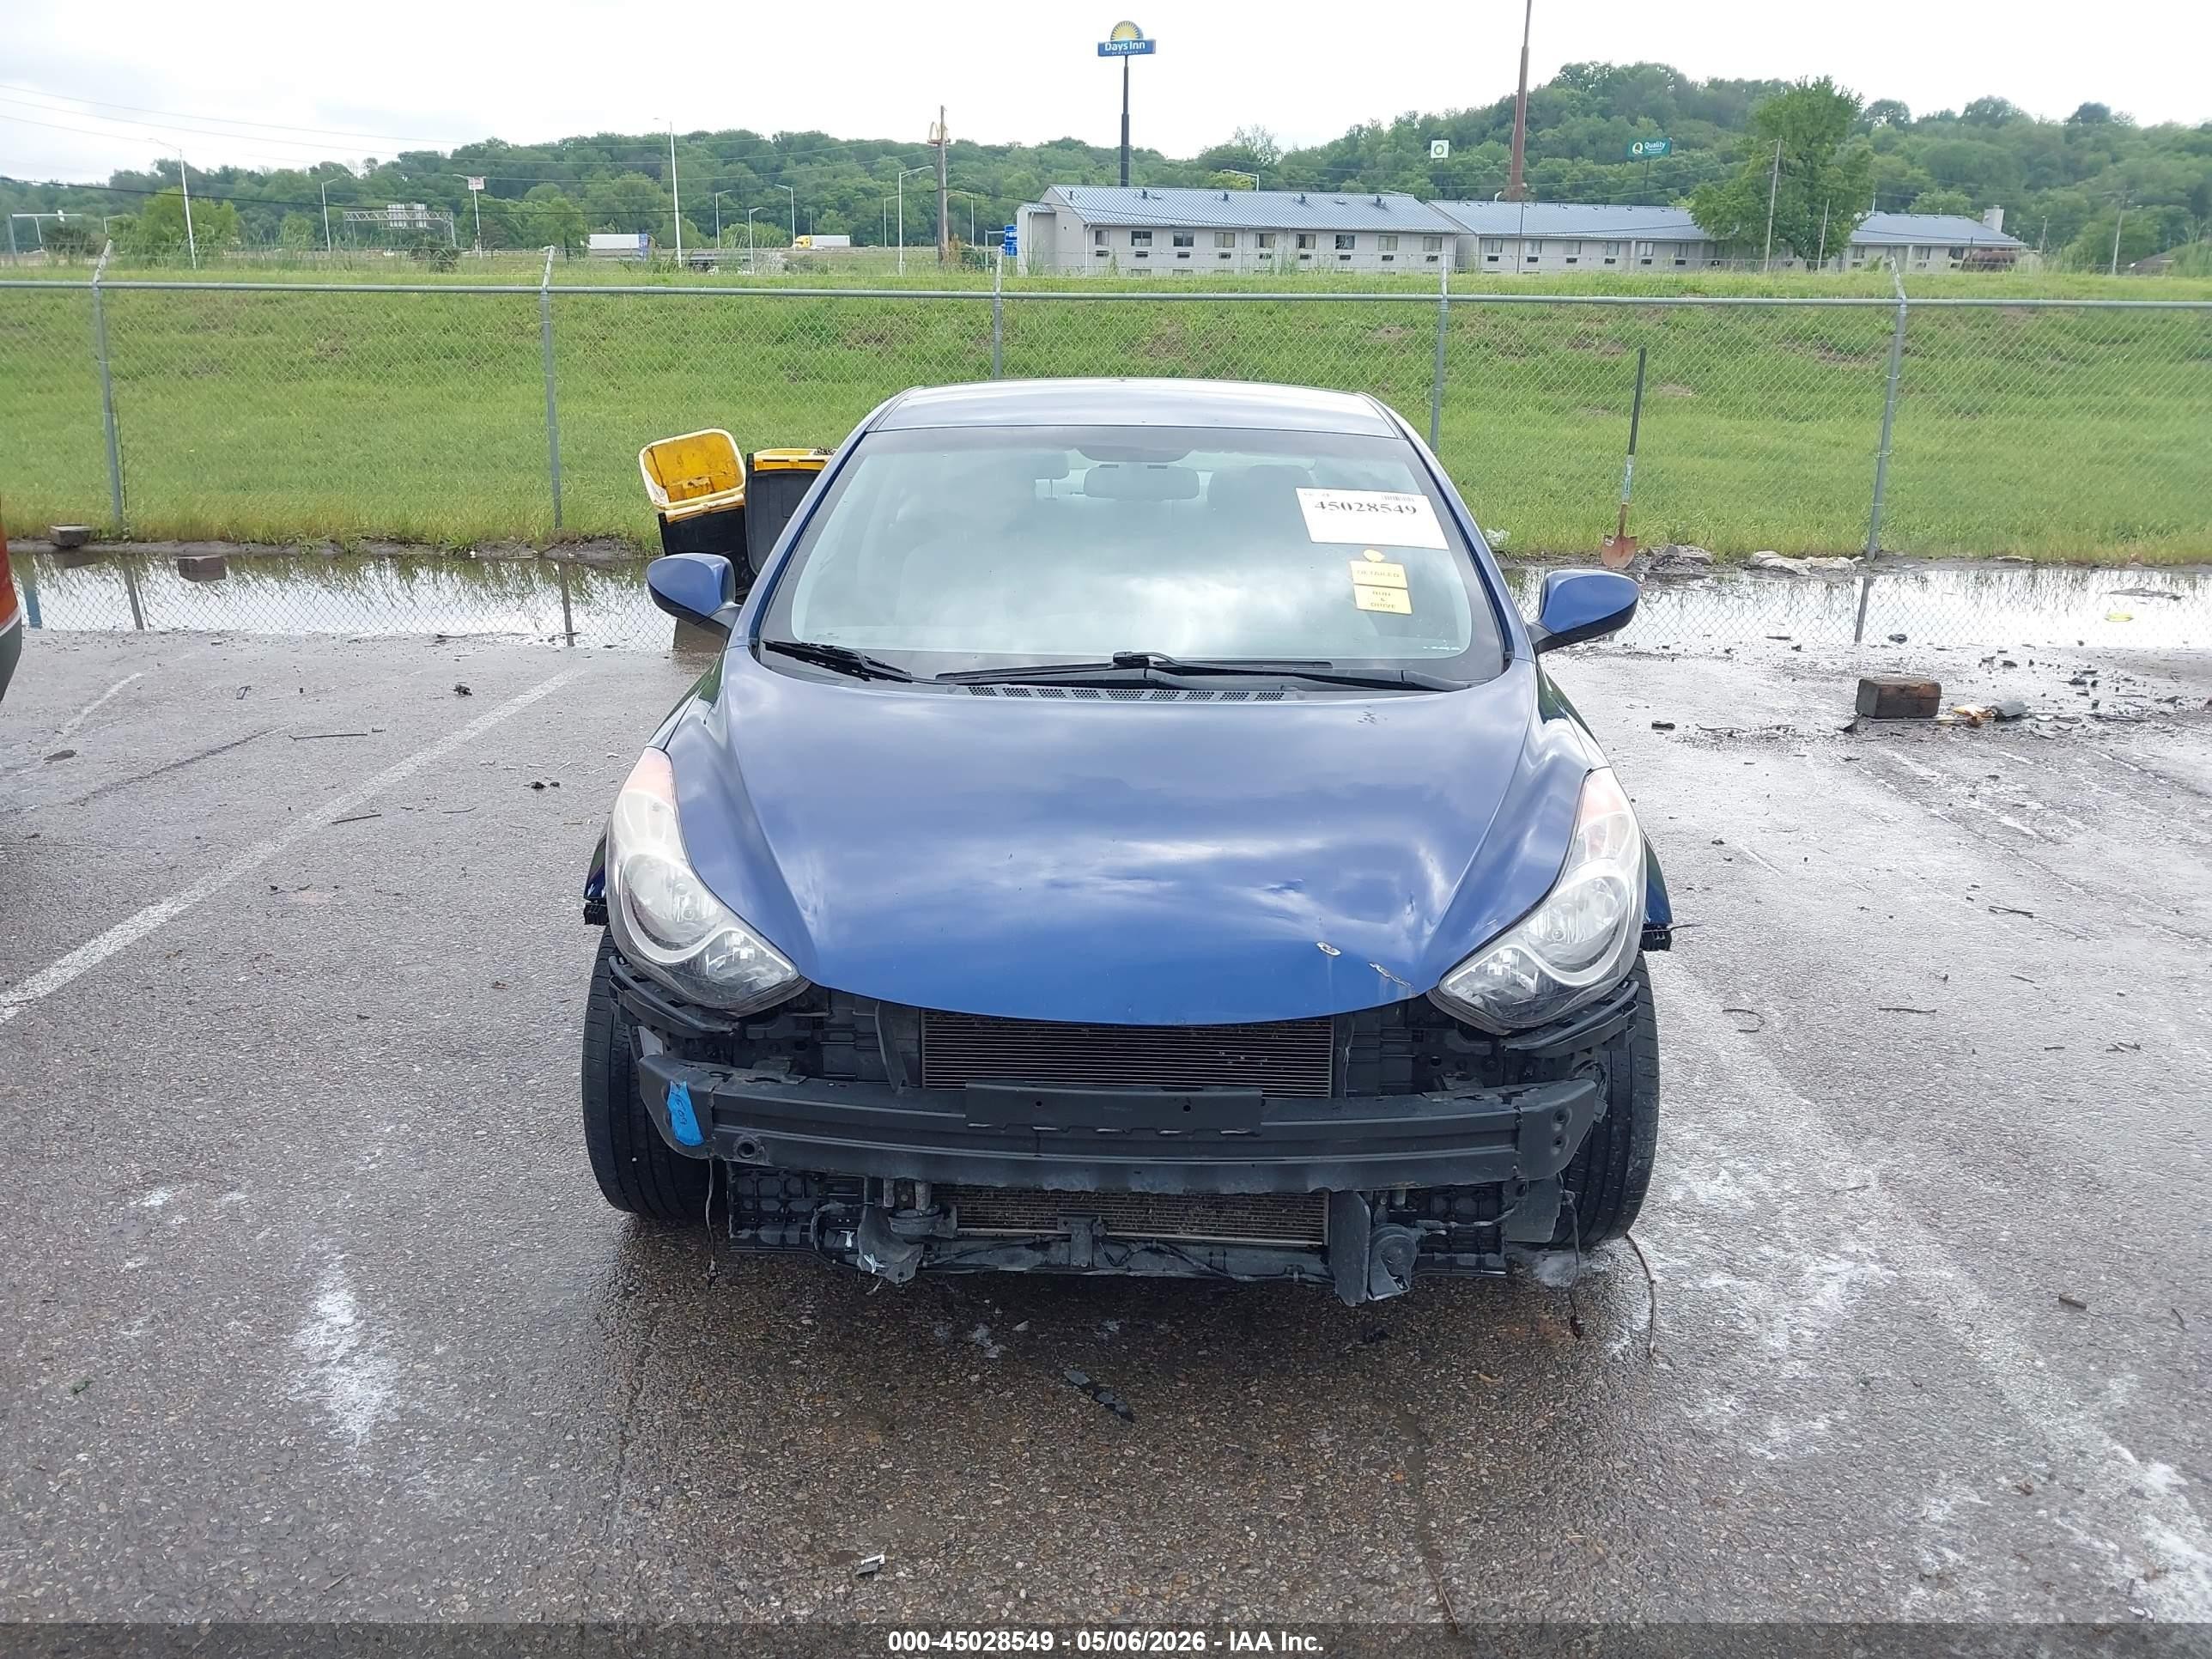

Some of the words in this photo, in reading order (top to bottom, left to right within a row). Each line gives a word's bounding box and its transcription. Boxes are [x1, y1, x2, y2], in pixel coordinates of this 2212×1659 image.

[1104, 42, 1128, 52] Days
[1129, 40, 1146, 50] Inn
[1644, 141, 1666, 150] Quality
[1314, 501, 1417, 515] 45028549
